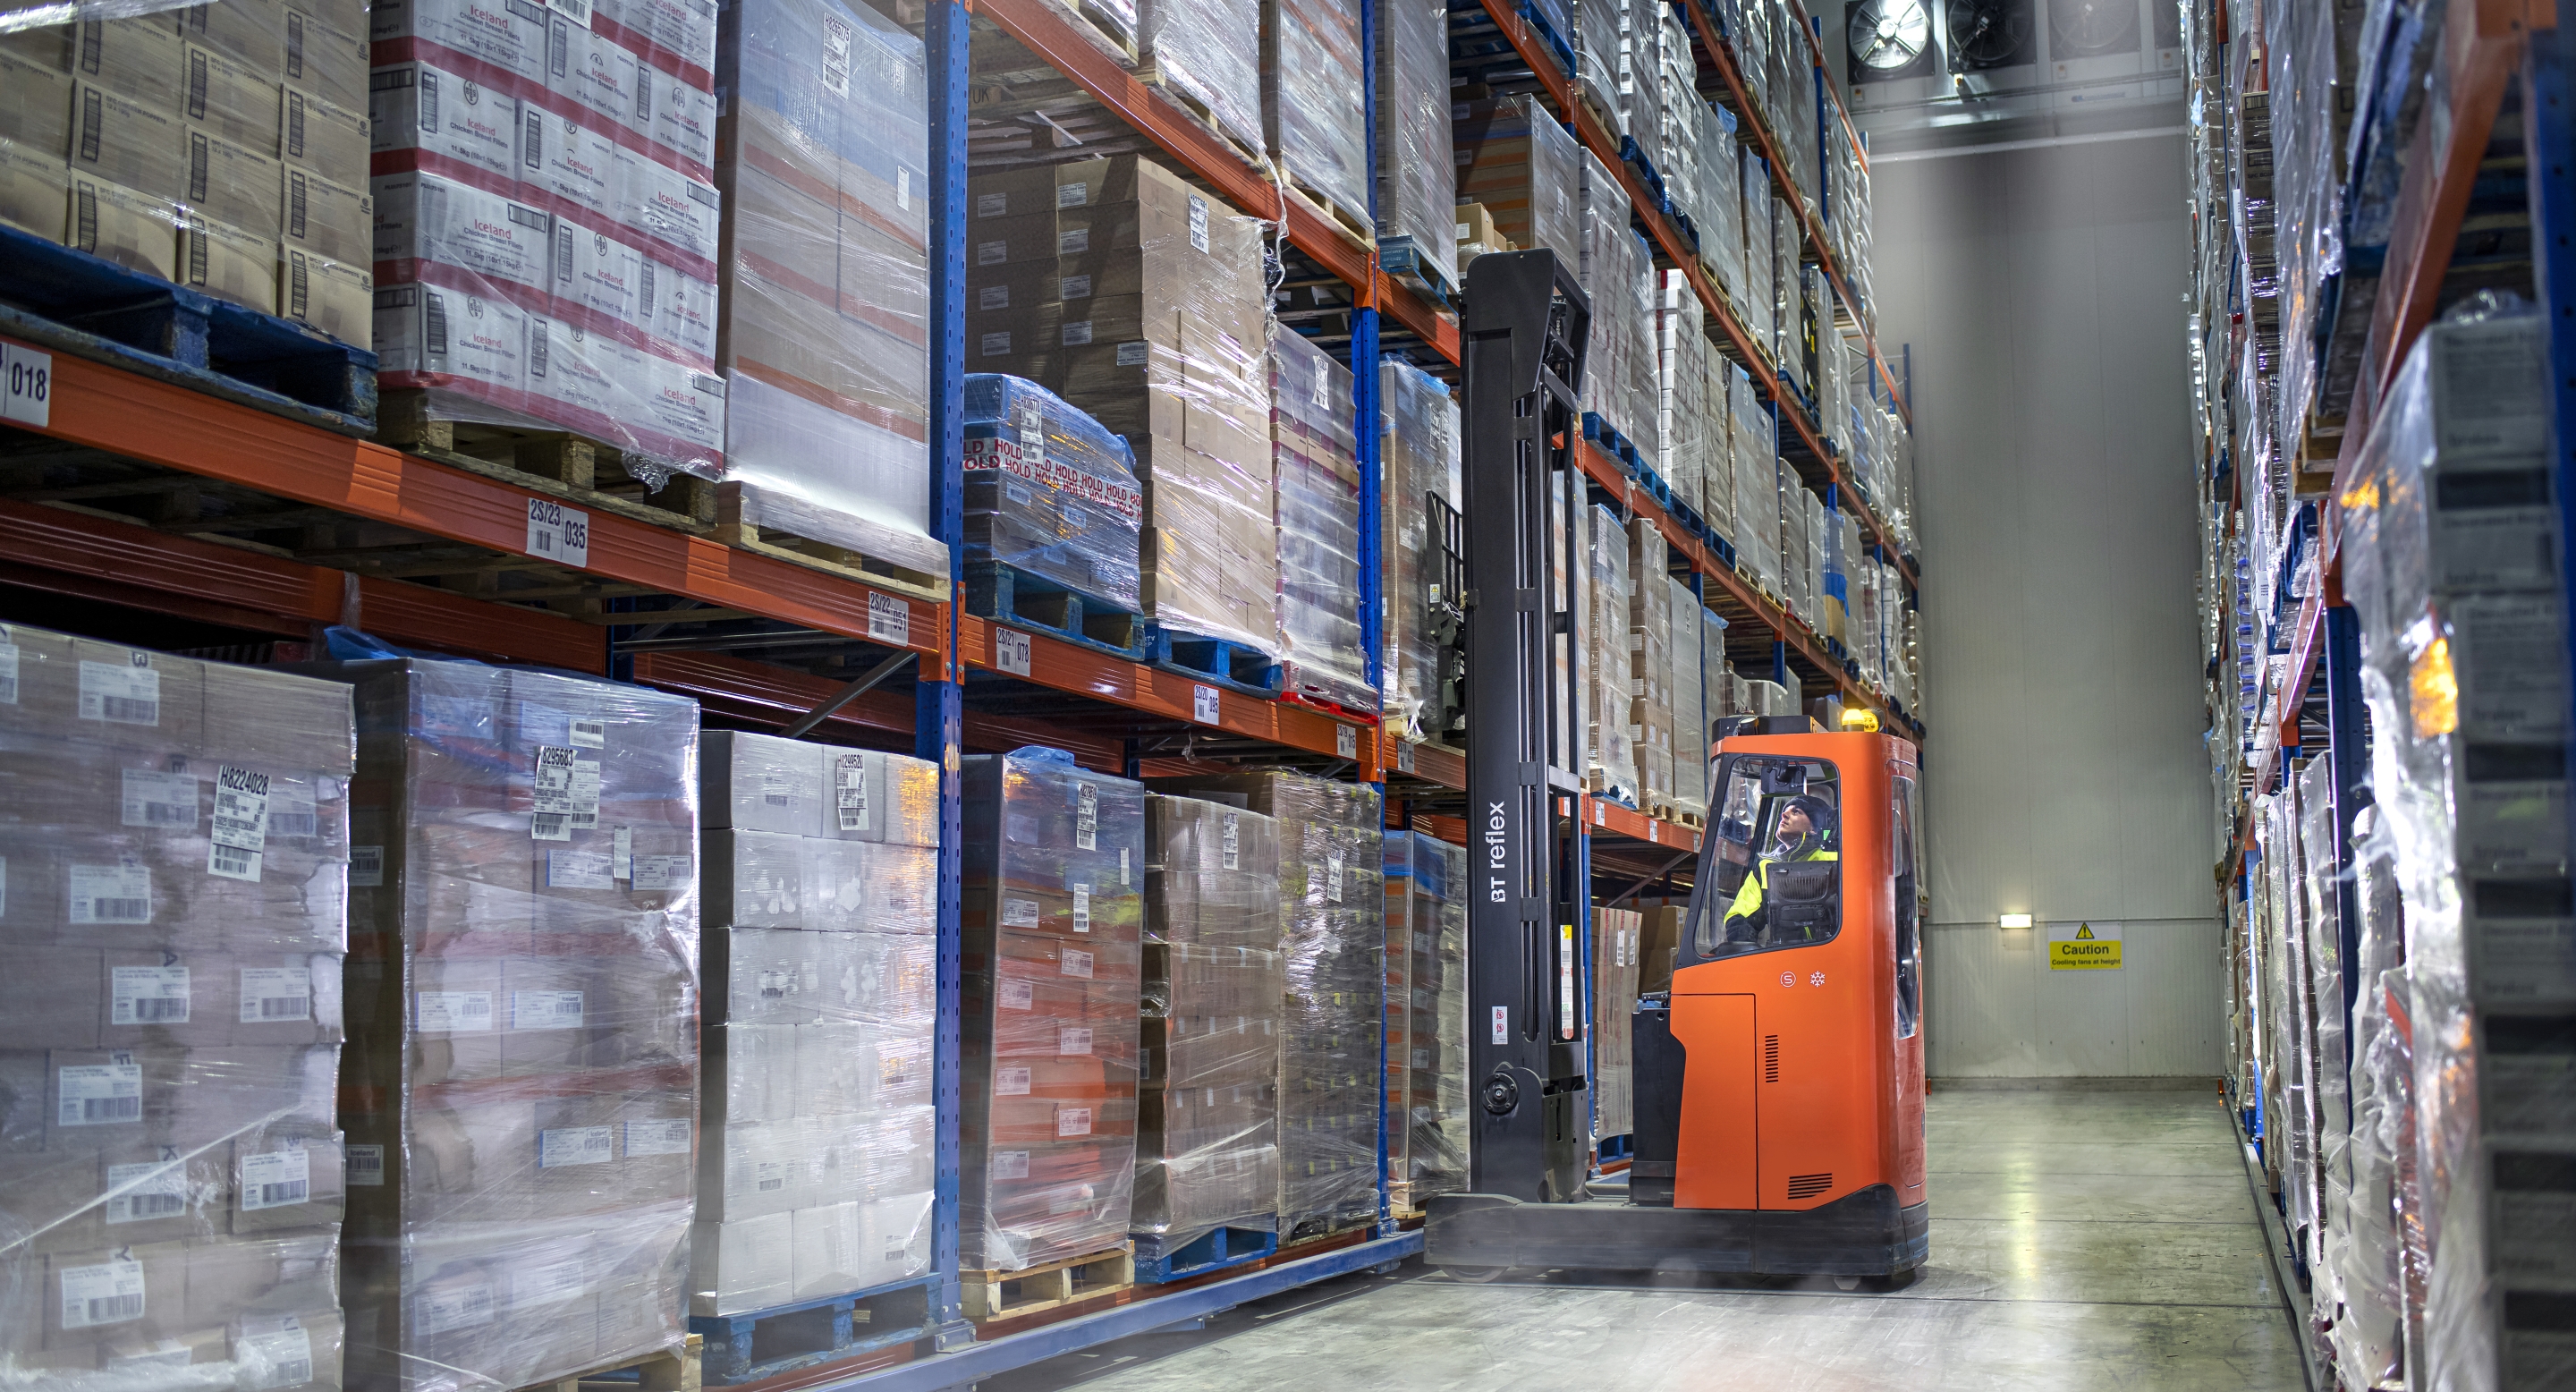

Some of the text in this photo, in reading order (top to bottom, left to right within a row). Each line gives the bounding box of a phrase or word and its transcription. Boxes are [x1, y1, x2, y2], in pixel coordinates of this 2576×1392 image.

[470, 4, 508, 29] Iceland
[460, 12, 521, 42] Chicken Breast Fillets
[576, 69, 629, 101] Chicken Breast Fillets
[592, 68, 618, 88] Iceland
[142, 109, 167, 125] POPPETS
[467, 118, 496, 136] Iceland
[660, 112, 680, 127] Chicken
[674, 111, 699, 130] Iceland
[450, 122, 508, 149] Chicken Breast Fillets
[551, 159, 573, 173] Chicken
[573, 168, 590, 181] Breast
[567, 157, 593, 175] Iceland
[339, 187, 360, 200] POPPETS
[658, 191, 690, 214] Iceland
[648, 197, 669, 210] Chicken
[684, 213, 699, 225] Fillets
[463, 226, 524, 251] Chicken Breast Fillets
[474, 218, 512, 241] Iceland
[338, 266, 360, 278] POPPETS
[582, 271, 604, 285] Chicken
[604, 280, 619, 293] Breast
[597, 268, 623, 286] Iceland
[677, 304, 700, 320] Iceland
[460, 339, 483, 352] Chicken
[473, 333, 502, 349] Iceland
[574, 361, 601, 378] Iceland
[12, 362, 47, 402] 018
[655, 394, 675, 406] Chicken
[664, 386, 696, 406] Iceland
[963, 440, 985, 454] LD
[995, 439, 1022, 460] HOLD
[1055, 465, 1078, 483] HOLD
[1081, 474, 1103, 492] HOLD
[1106, 484, 1127, 501] HOLD
[964, 454, 1001, 471] OLD
[1005, 458, 1030, 479] HOLD
[1035, 470, 1059, 488] HOLD
[1063, 480, 1086, 498] HOLD
[1113, 500, 1134, 518] HOLD
[530, 499, 561, 526] 2S/23
[565, 520, 586, 549] 035
[870, 592, 891, 614] 2S/22
[893, 608, 907, 632] 051
[997, 628, 1014, 648] 2S/21
[1017, 641, 1030, 664] 078
[1195, 685, 1208, 701] 2S/20
[1208, 696, 1219, 714] 095
[540, 746, 573, 768] 8295683
[837, 753, 864, 769] H8299520
[220, 765, 269, 796] H8224028
[351, 850, 376, 858] celand
[1485, 801, 1506, 903] BT reflex
[2062, 944, 2110, 955] Caution
[351, 1148, 376, 1157] Iceland
